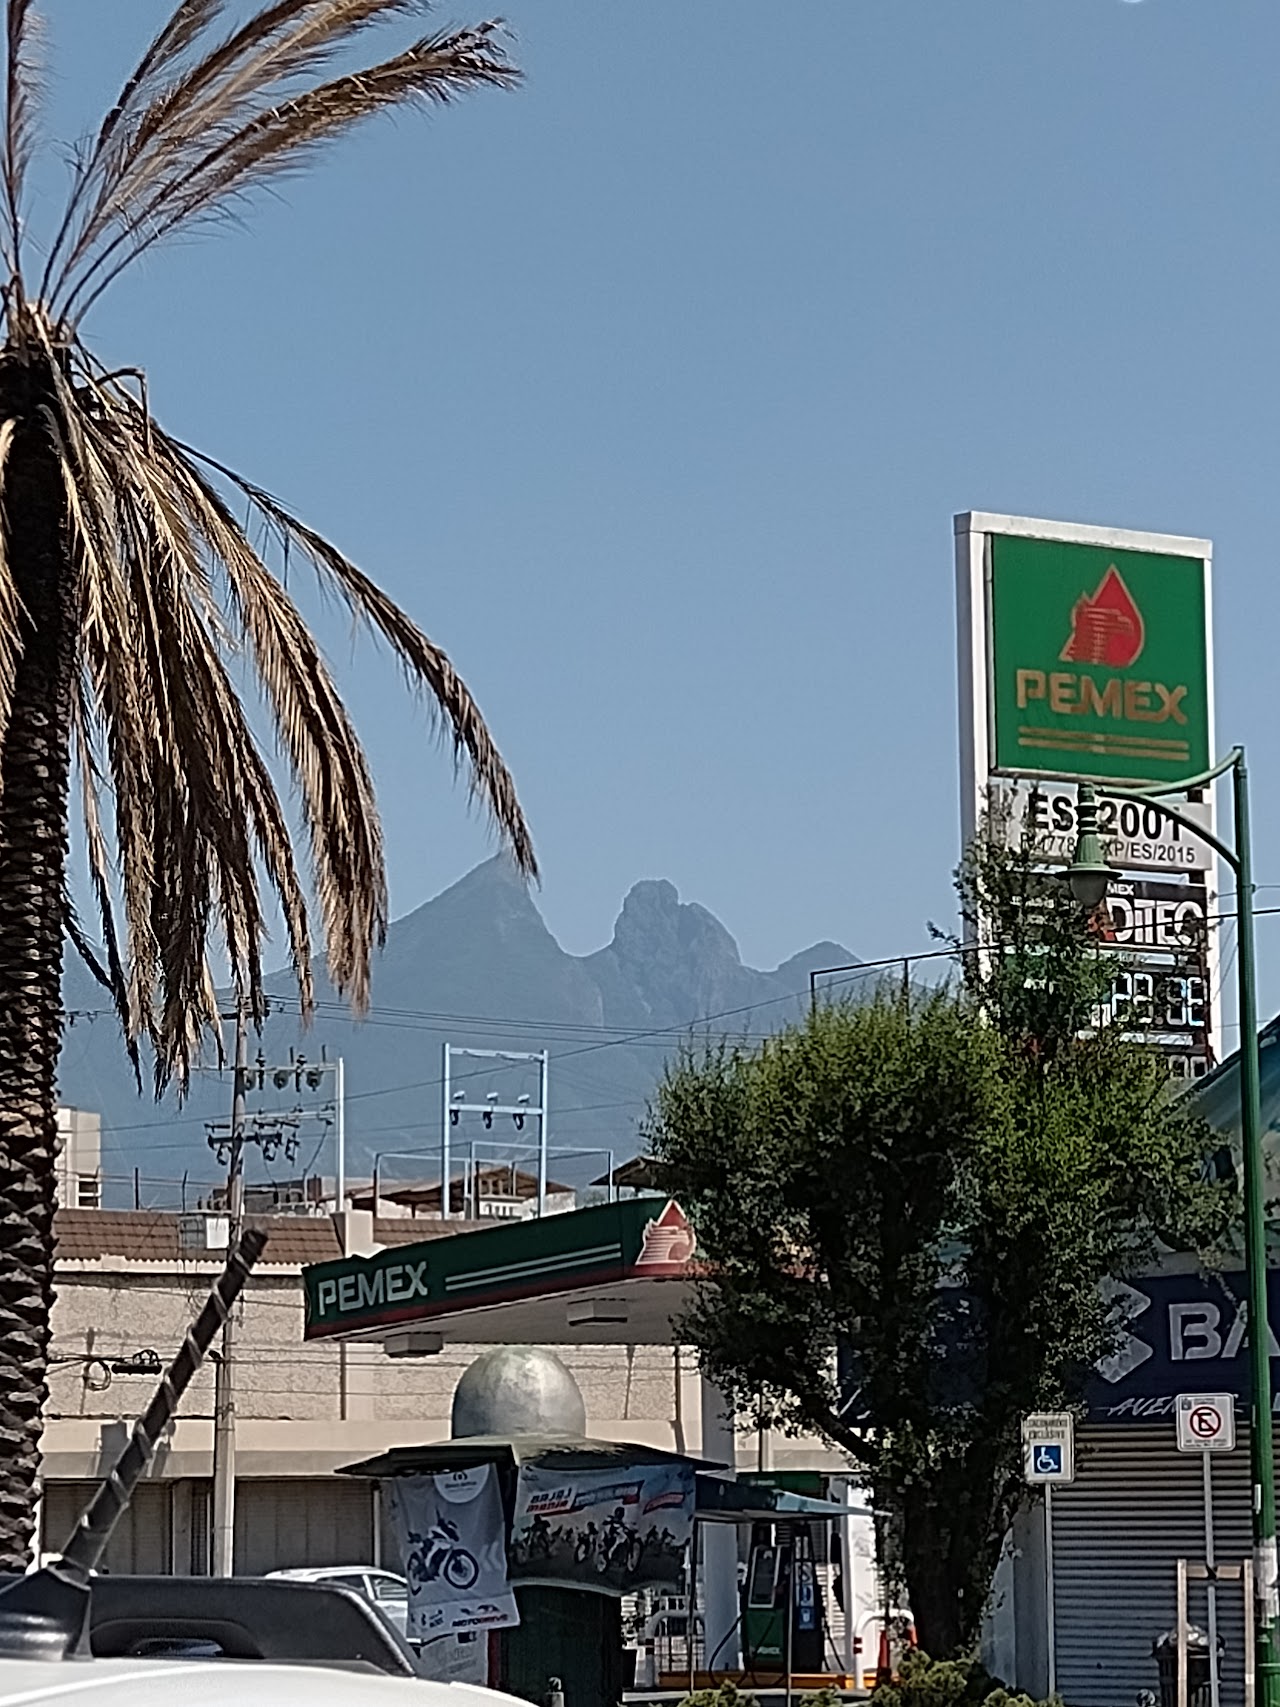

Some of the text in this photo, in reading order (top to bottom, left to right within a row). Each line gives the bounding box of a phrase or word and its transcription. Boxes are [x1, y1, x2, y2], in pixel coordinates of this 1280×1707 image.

[1016, 668, 1188, 725] PEMEX
[1099, 801, 1182, 841] 2001
[1102, 837, 1196, 864] XP/ES/2015
[318, 1261, 429, 1316] PEMEX
